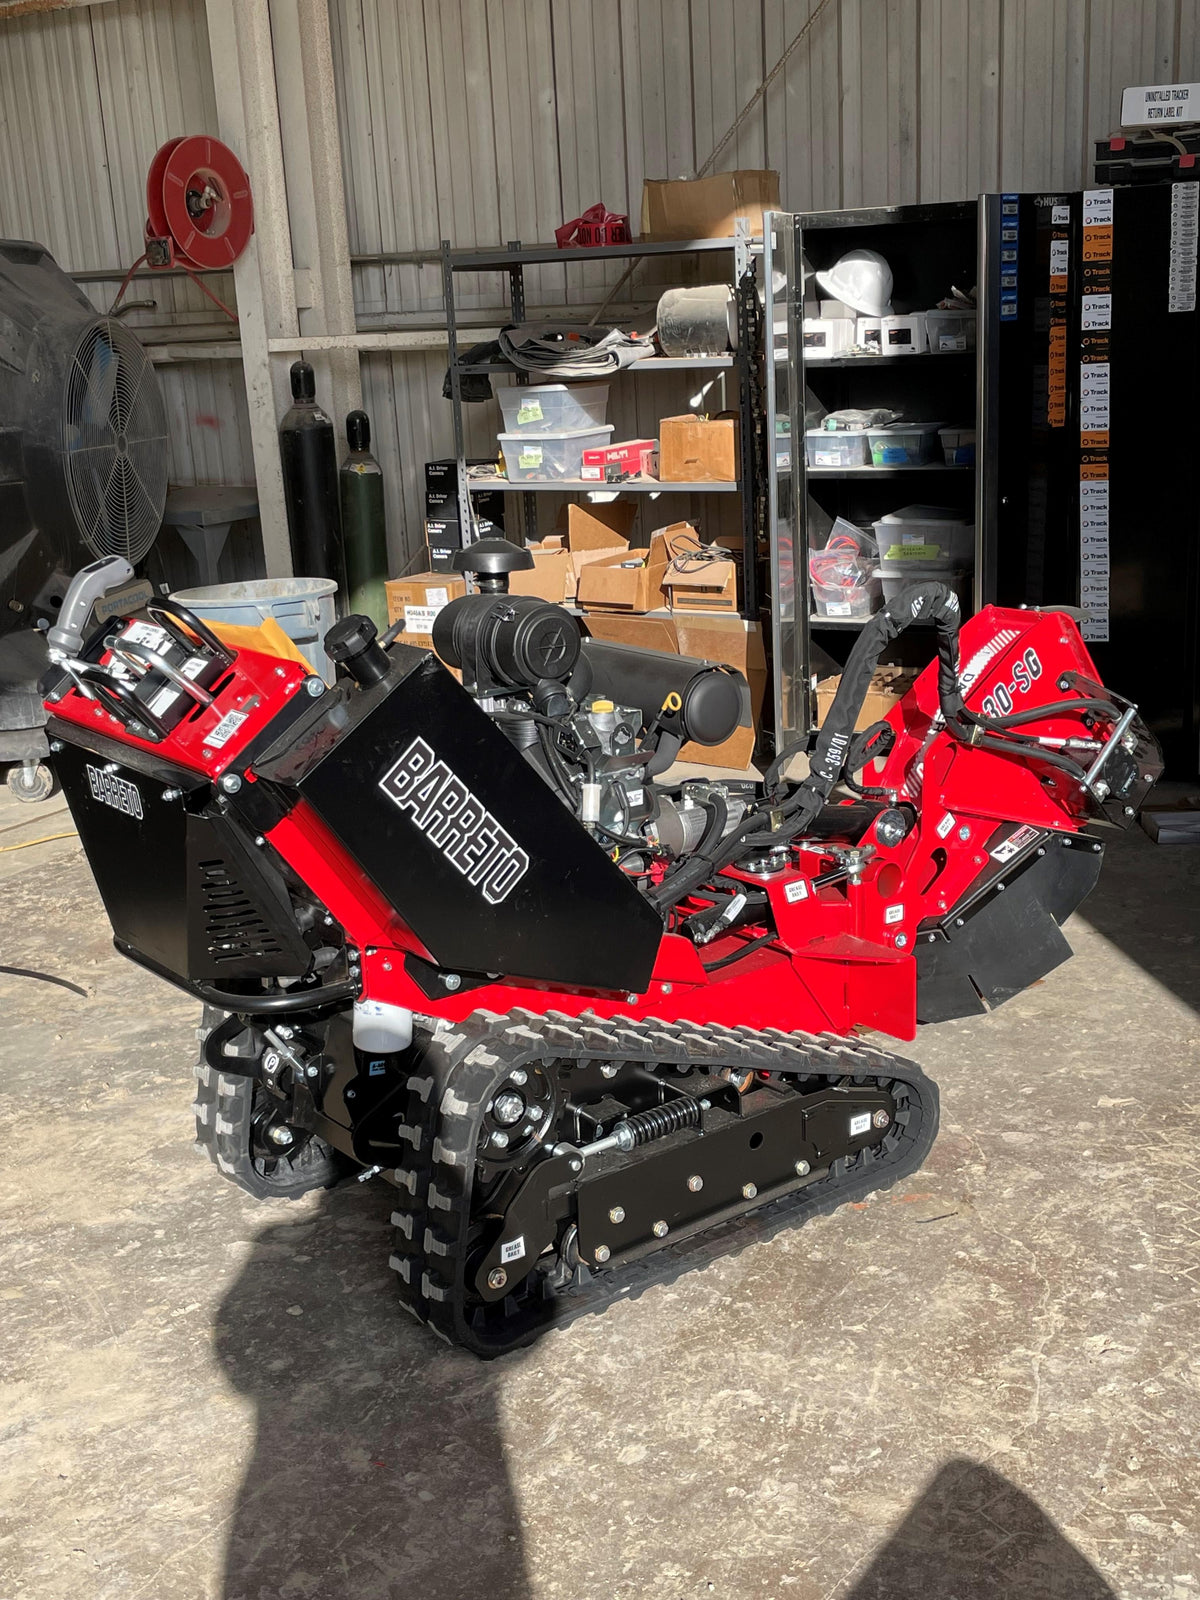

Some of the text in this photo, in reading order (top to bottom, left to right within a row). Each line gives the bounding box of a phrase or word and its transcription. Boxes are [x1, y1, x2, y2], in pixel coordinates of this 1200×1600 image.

[1148, 108, 1163, 118] RETURN
[1164, 107, 1176, 118] LABEL
[607, 450, 628, 461] HILTI
[102, 591, 148, 614] PORTACOOL
[982, 646, 1042, 718] 30-SG
[86, 764, 144, 820] BARRETO
[378, 736, 530, 904] BARRETO
